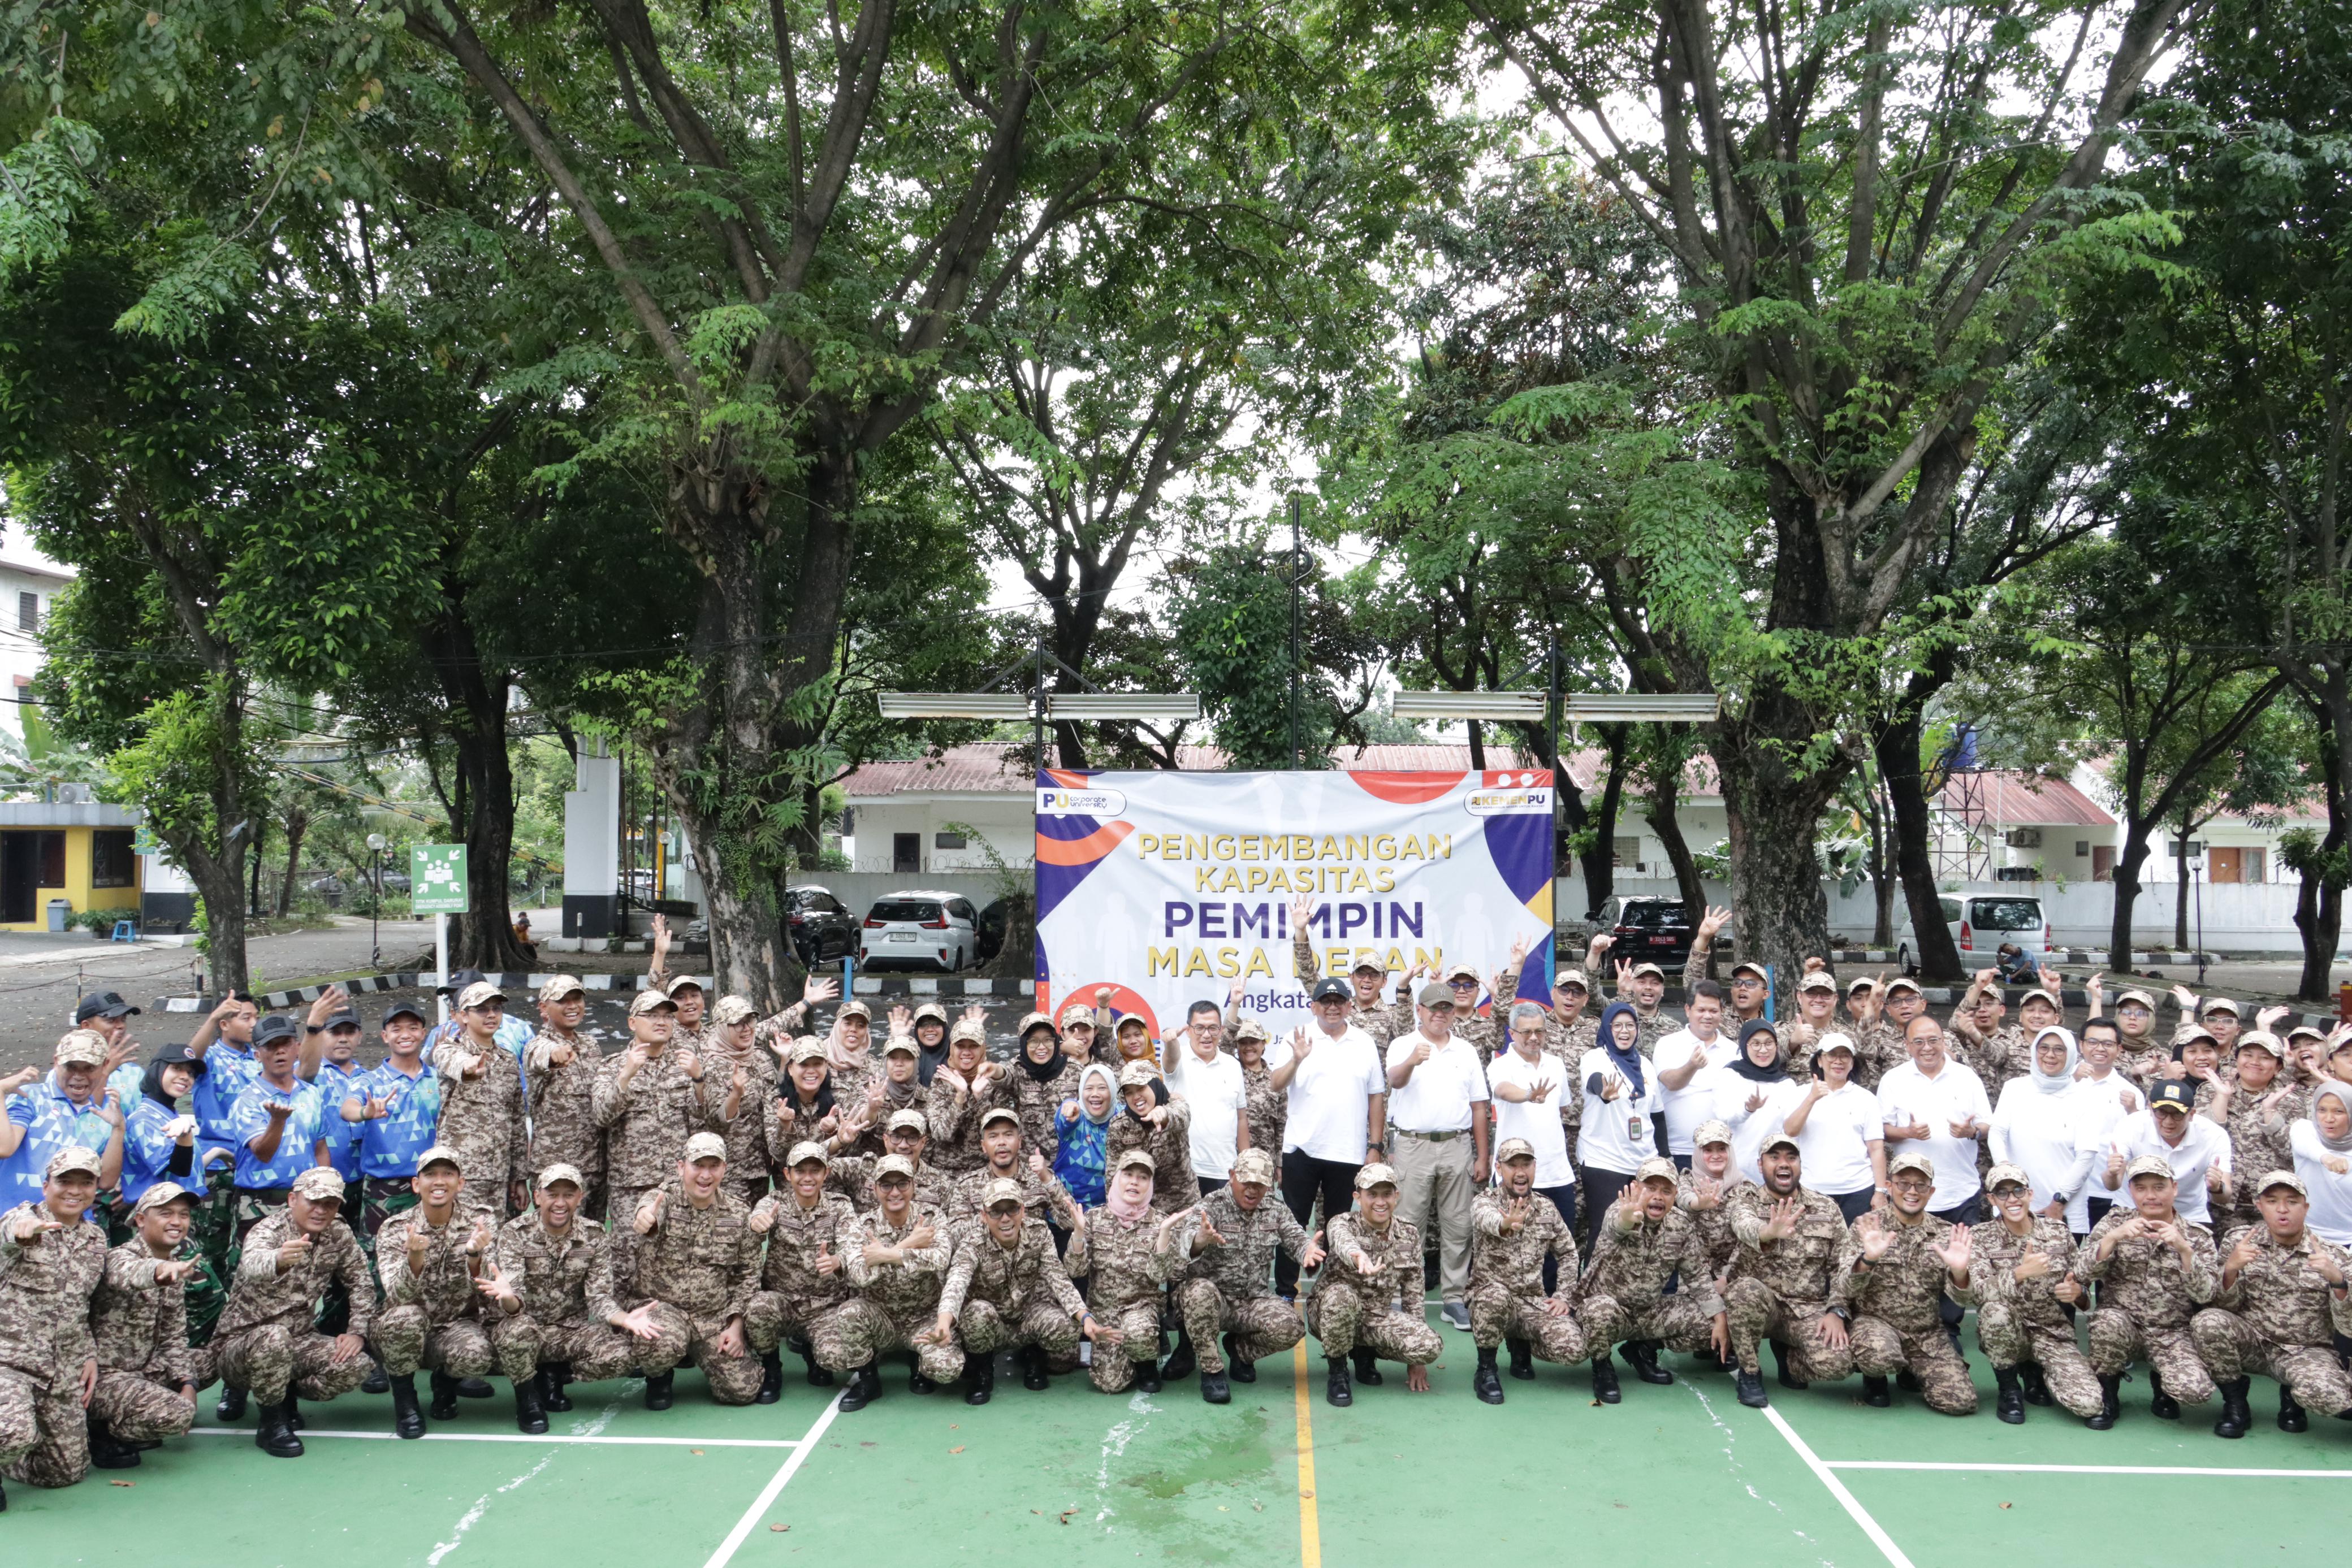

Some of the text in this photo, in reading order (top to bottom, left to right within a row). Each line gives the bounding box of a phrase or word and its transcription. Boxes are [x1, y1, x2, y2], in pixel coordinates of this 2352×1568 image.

[1043, 794, 1069, 808] PU
[1070, 796, 1106, 805] corporate
[1481, 795, 1545, 805] KEMENPU
[1138, 833, 1451, 860] PENGEMBANGAN
[1195, 865, 1396, 893] KAPASITAS
[1165, 901, 1423, 939] PEMIMPIN
[1147, 946, 1442, 978] MASA DEAN
